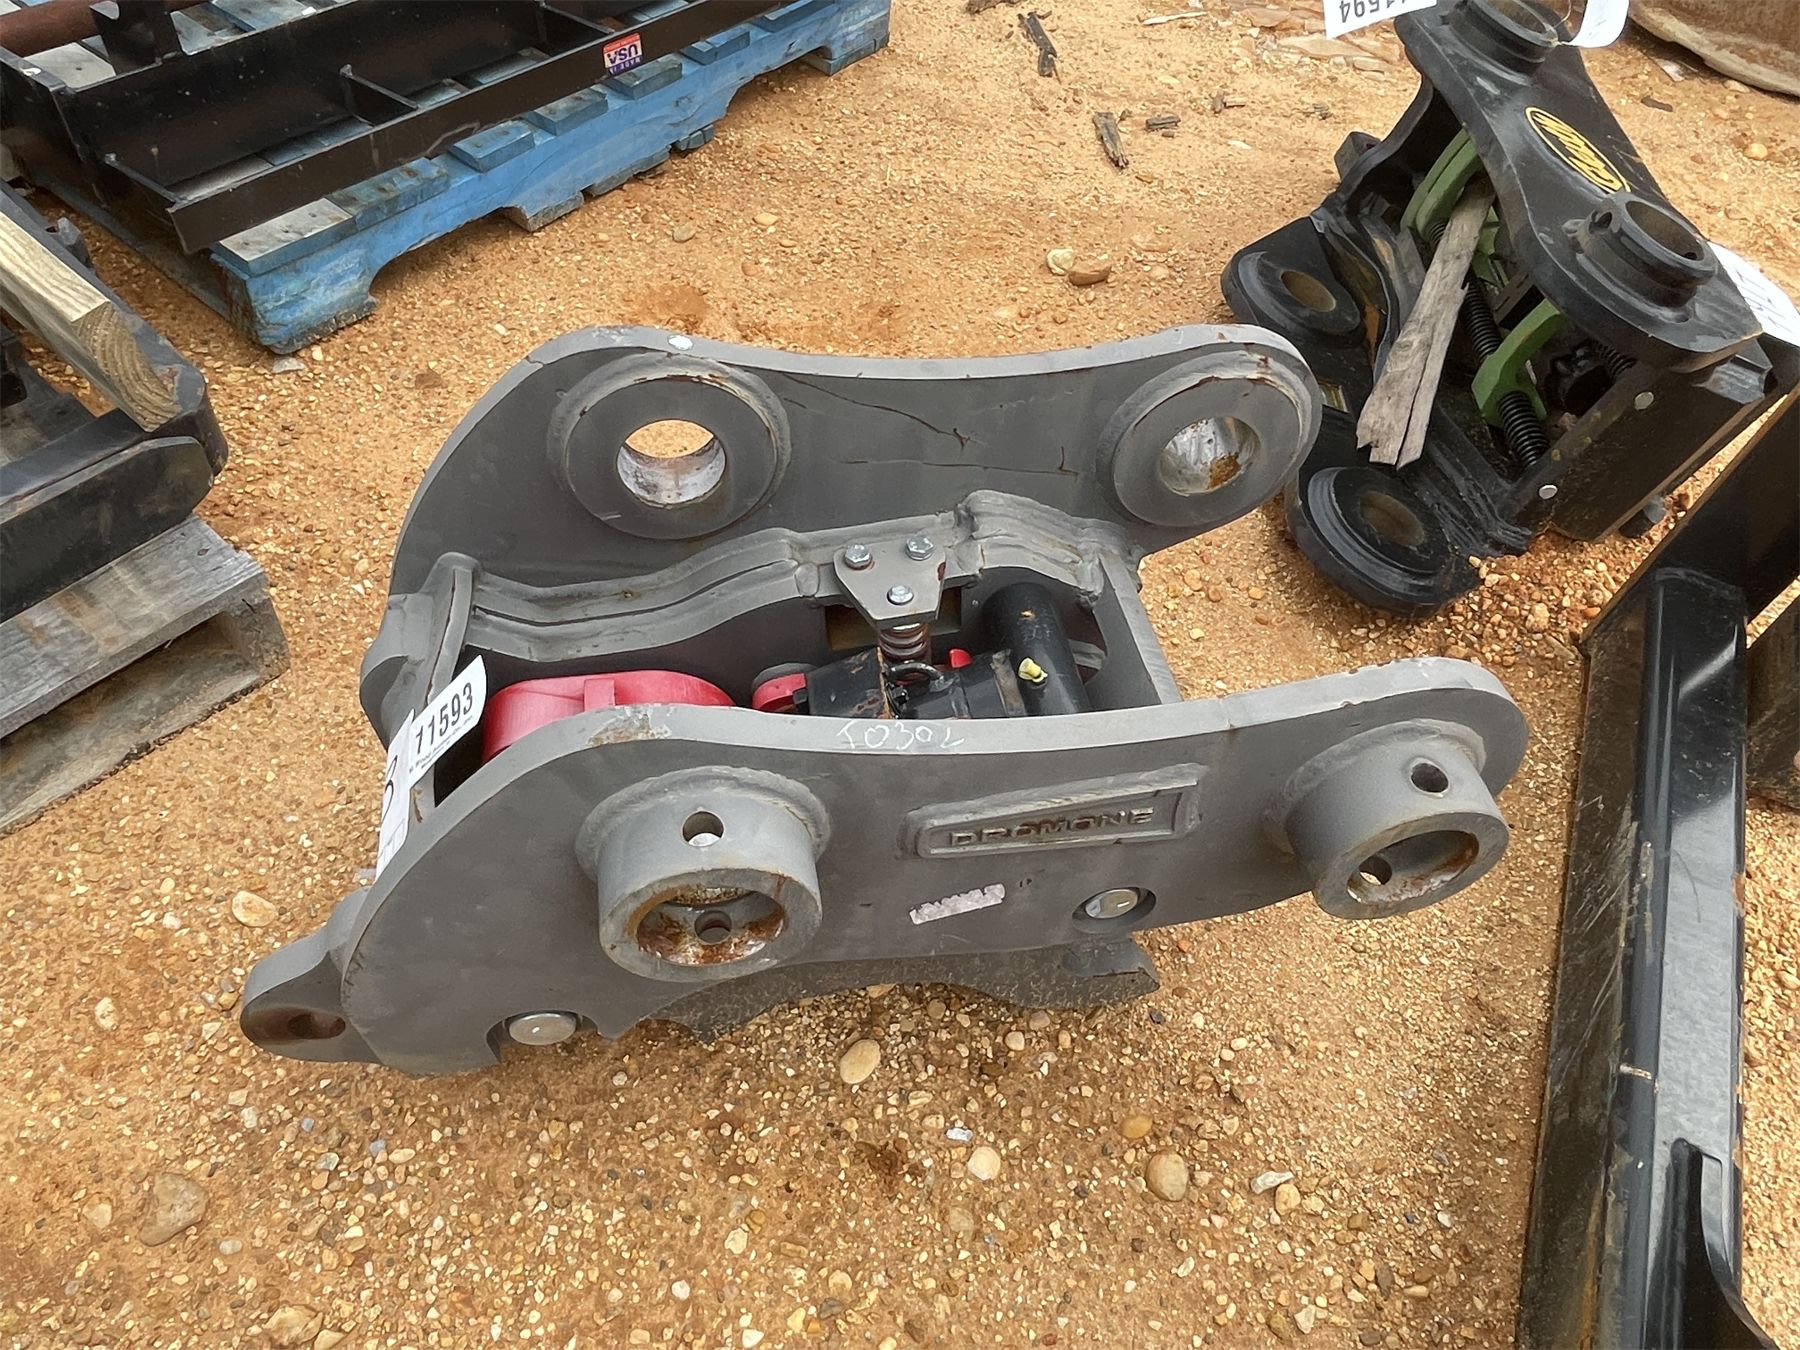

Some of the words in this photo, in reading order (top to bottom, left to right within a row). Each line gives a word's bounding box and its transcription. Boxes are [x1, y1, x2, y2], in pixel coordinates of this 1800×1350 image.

[1340, 0, 1406, 23] 594
[607, 44, 638, 64] USA
[415, 682, 473, 755] 11593
[950, 807, 1154, 846] DROMONE
